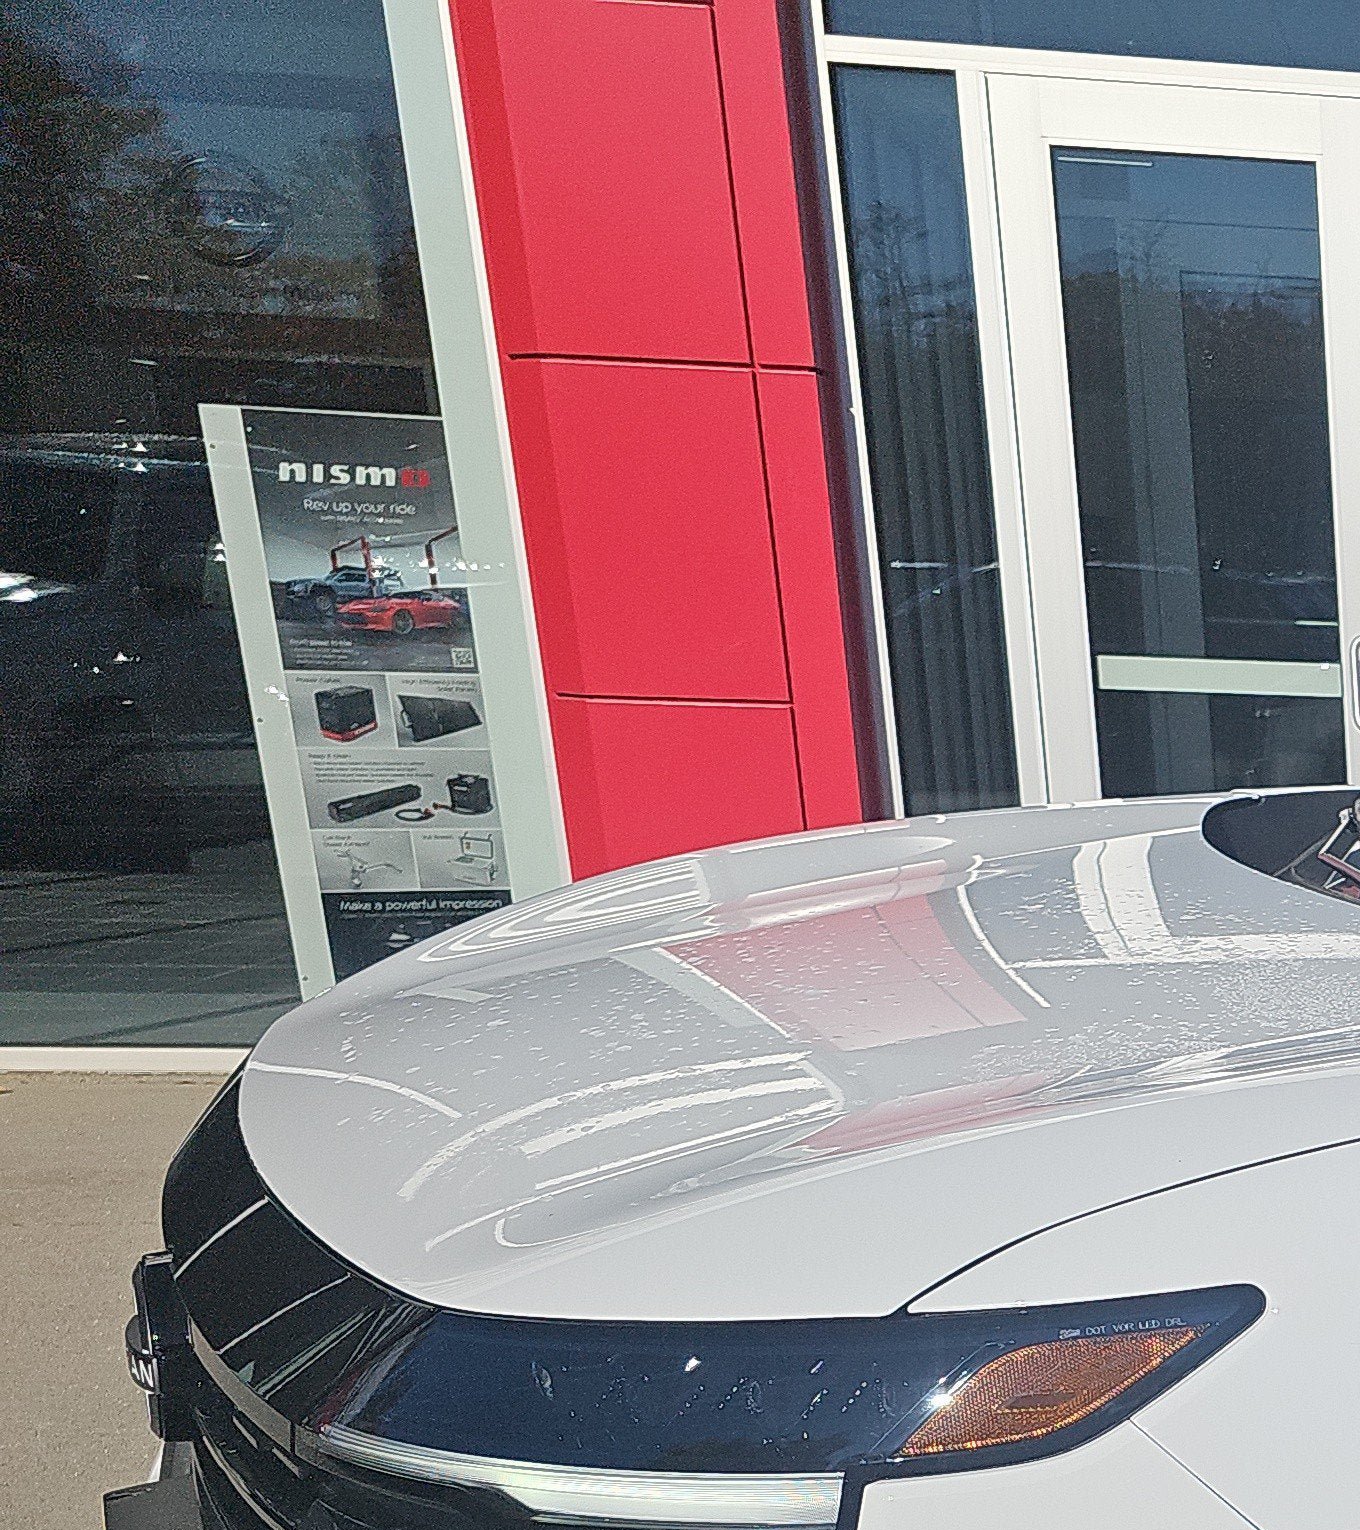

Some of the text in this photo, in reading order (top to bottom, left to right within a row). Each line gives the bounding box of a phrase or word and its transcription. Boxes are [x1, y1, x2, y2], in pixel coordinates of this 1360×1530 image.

[303, 499, 417, 516] Rev up your ride
